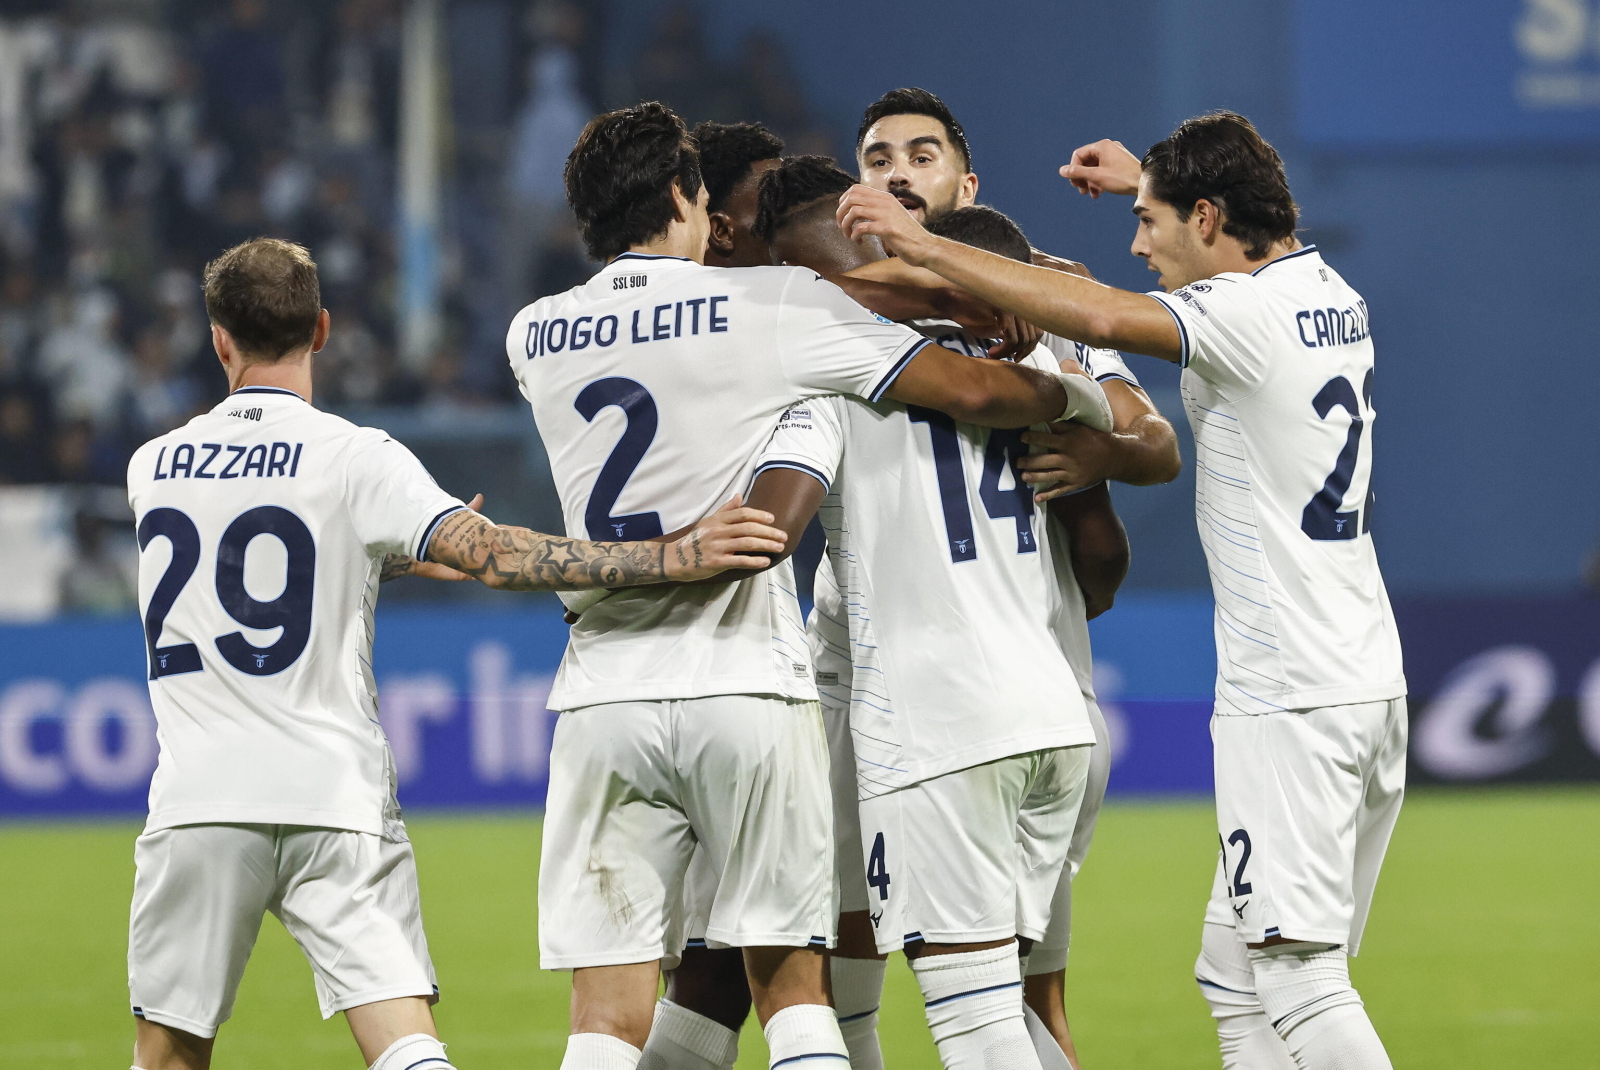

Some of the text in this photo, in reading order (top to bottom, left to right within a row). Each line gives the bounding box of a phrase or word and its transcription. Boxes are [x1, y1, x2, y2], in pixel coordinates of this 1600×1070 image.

[525, 295, 729, 360] DIOGO LEITE
[613, 275, 647, 290] SSL 900
[153, 442, 303, 481] LAZZARI
[573, 375, 664, 542] 2
[906, 403, 1037, 565] 14
[137, 504, 316, 680] 29
